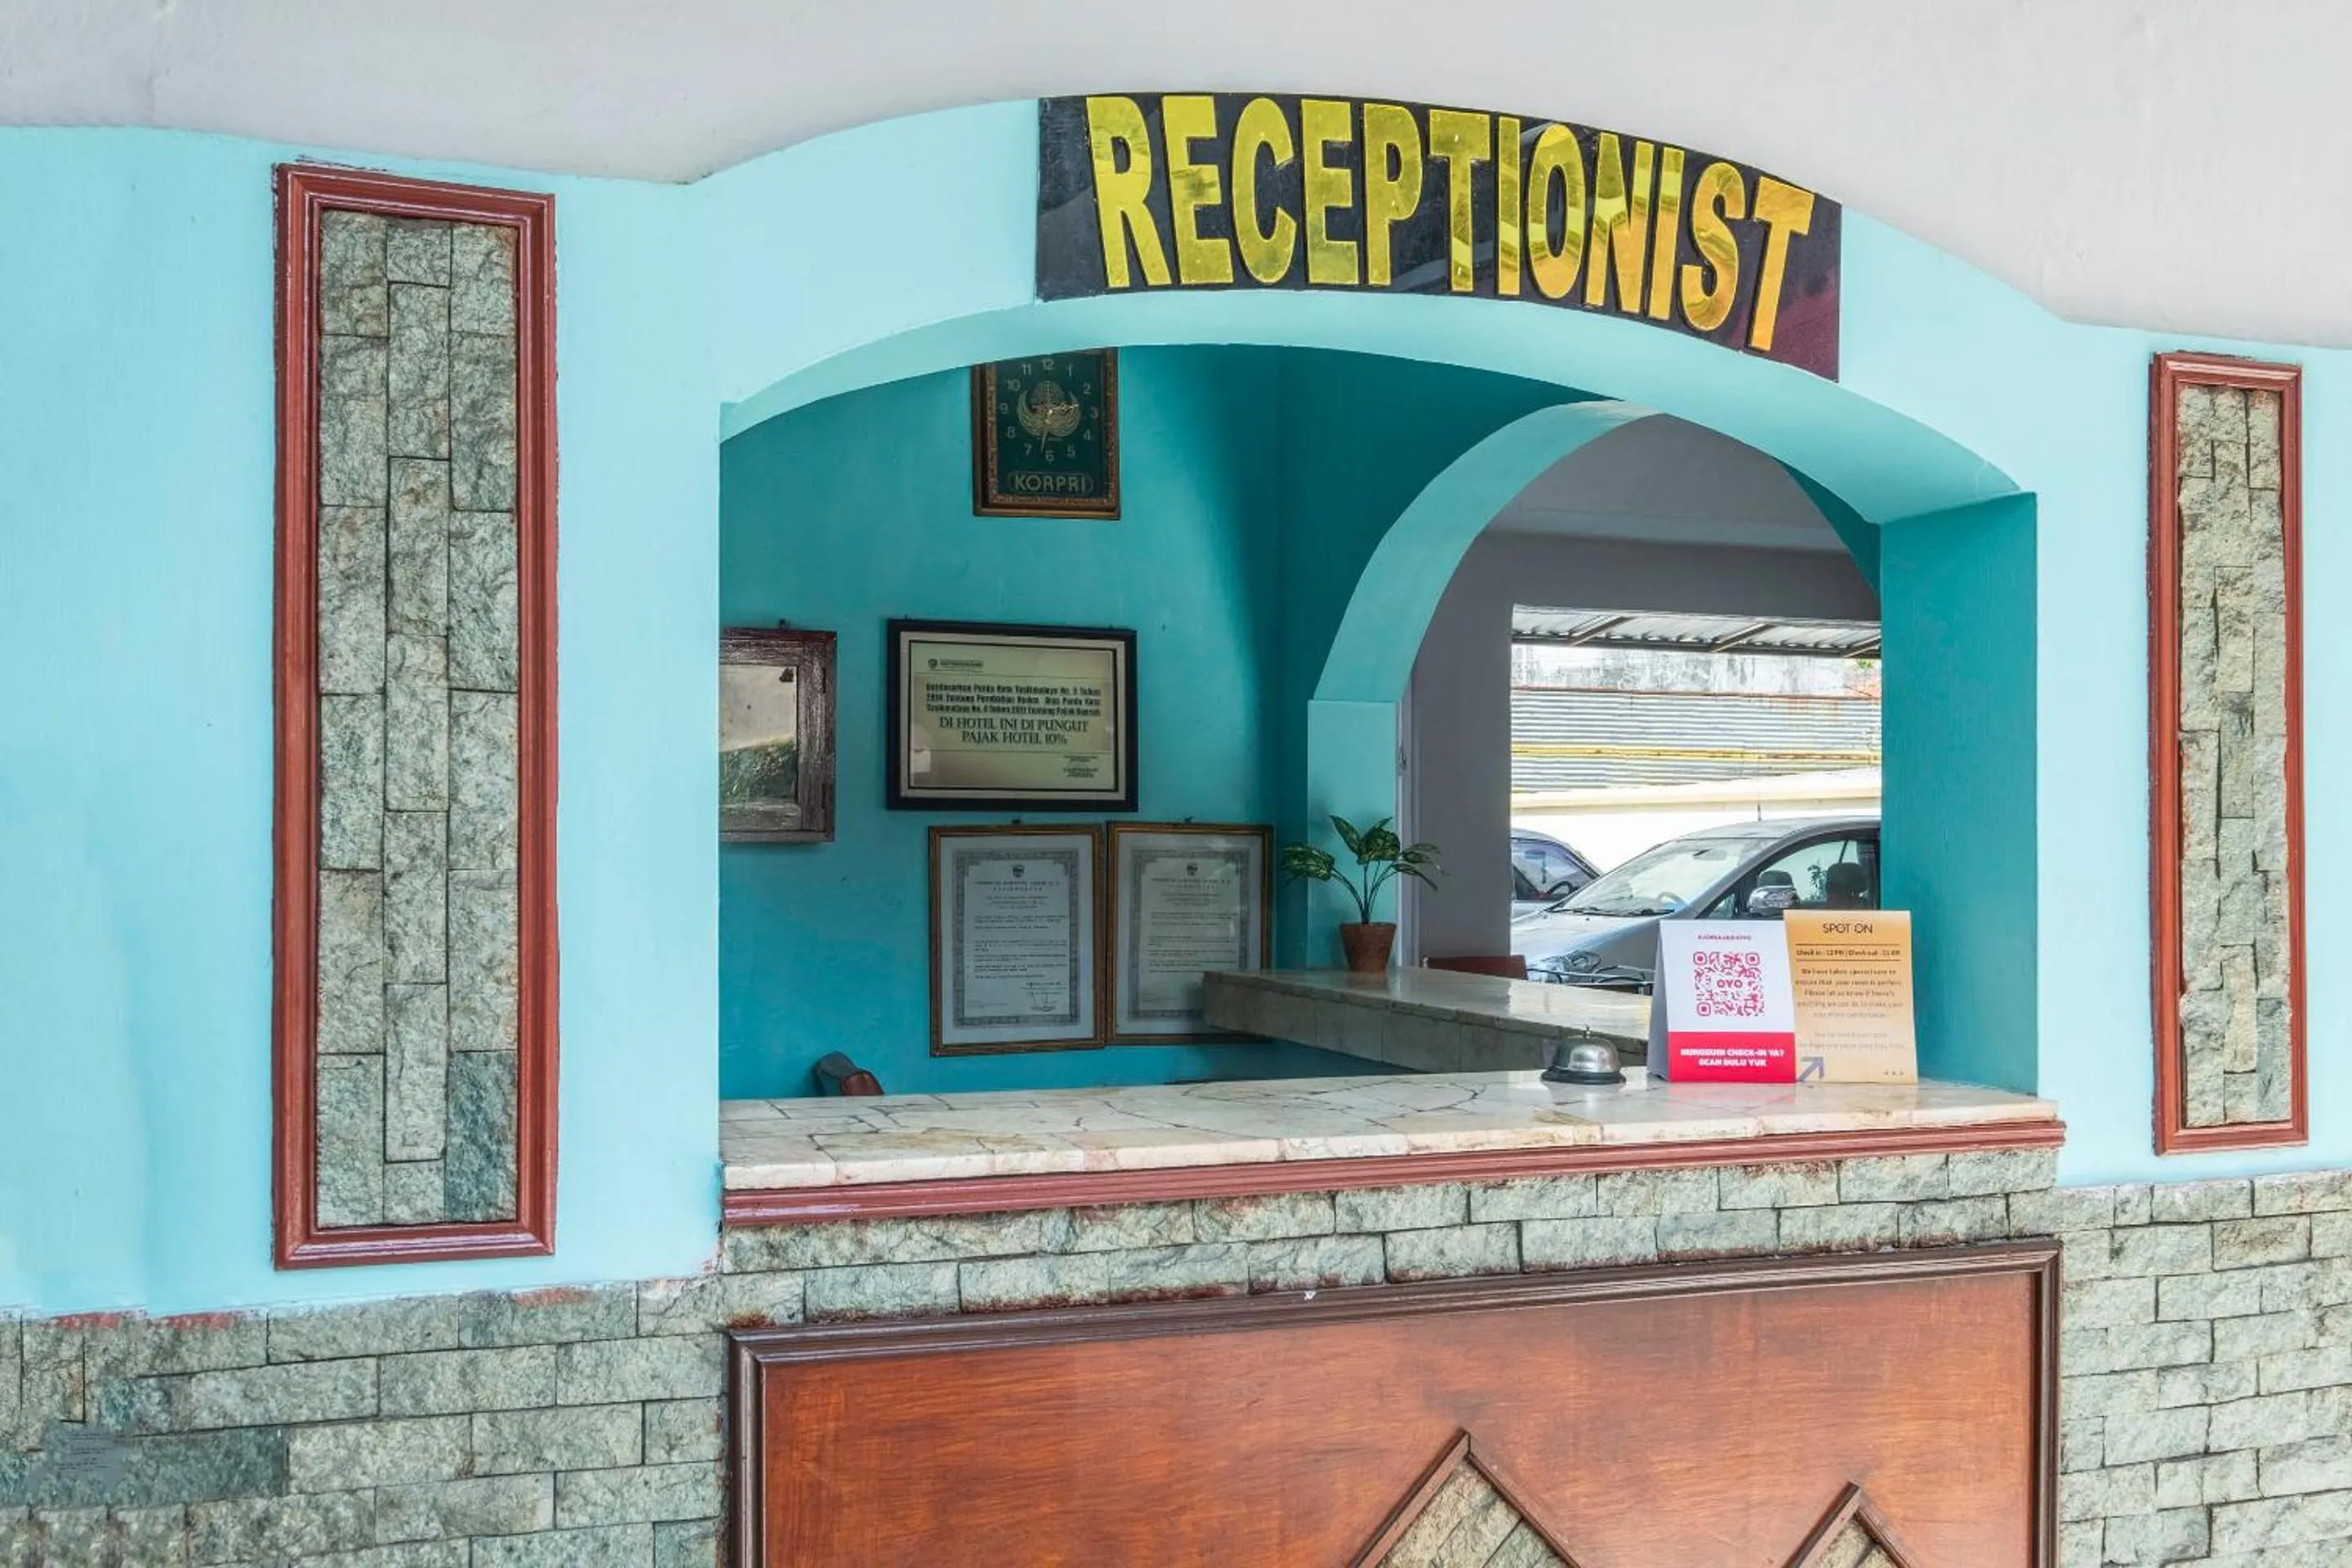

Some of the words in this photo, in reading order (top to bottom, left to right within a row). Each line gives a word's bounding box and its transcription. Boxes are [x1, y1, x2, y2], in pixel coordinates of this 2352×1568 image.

[1086, 95, 1815, 352] RECEPTIONIST
[1022, 363, 1032, 376] 11
[1041, 358, 1054, 371] 12
[1067, 364, 1073, 376] 1
[1006, 379, 1020, 392] 10
[1083, 382, 1091, 395] 2
[999, 403, 1009, 415] 9
[1090, 407, 1098, 419] 3
[1007, 425, 1016, 439] 8
[1083, 429, 1091, 442] 4
[1023, 442, 1032, 456] 7
[1067, 444, 1076, 459] 5
[1014, 474, 1086, 493] KORPRI
[939, 716, 952, 728] DI
[956, 718, 998, 730] HOTEL
[1000, 719, 1018, 731] INI
[1020, 719, 1035, 732] DI
[1036, 719, 1089, 733] PUNGUT
[961, 730, 1000, 744] PAJAK
[1003, 732, 1042, 744] HOTEL
[1045, 733, 1067, 745] 10%
[1823, 923, 1851, 934] SPOT
[1854, 923, 1873, 934] ON
[1717, 979, 1743, 988] OYO
